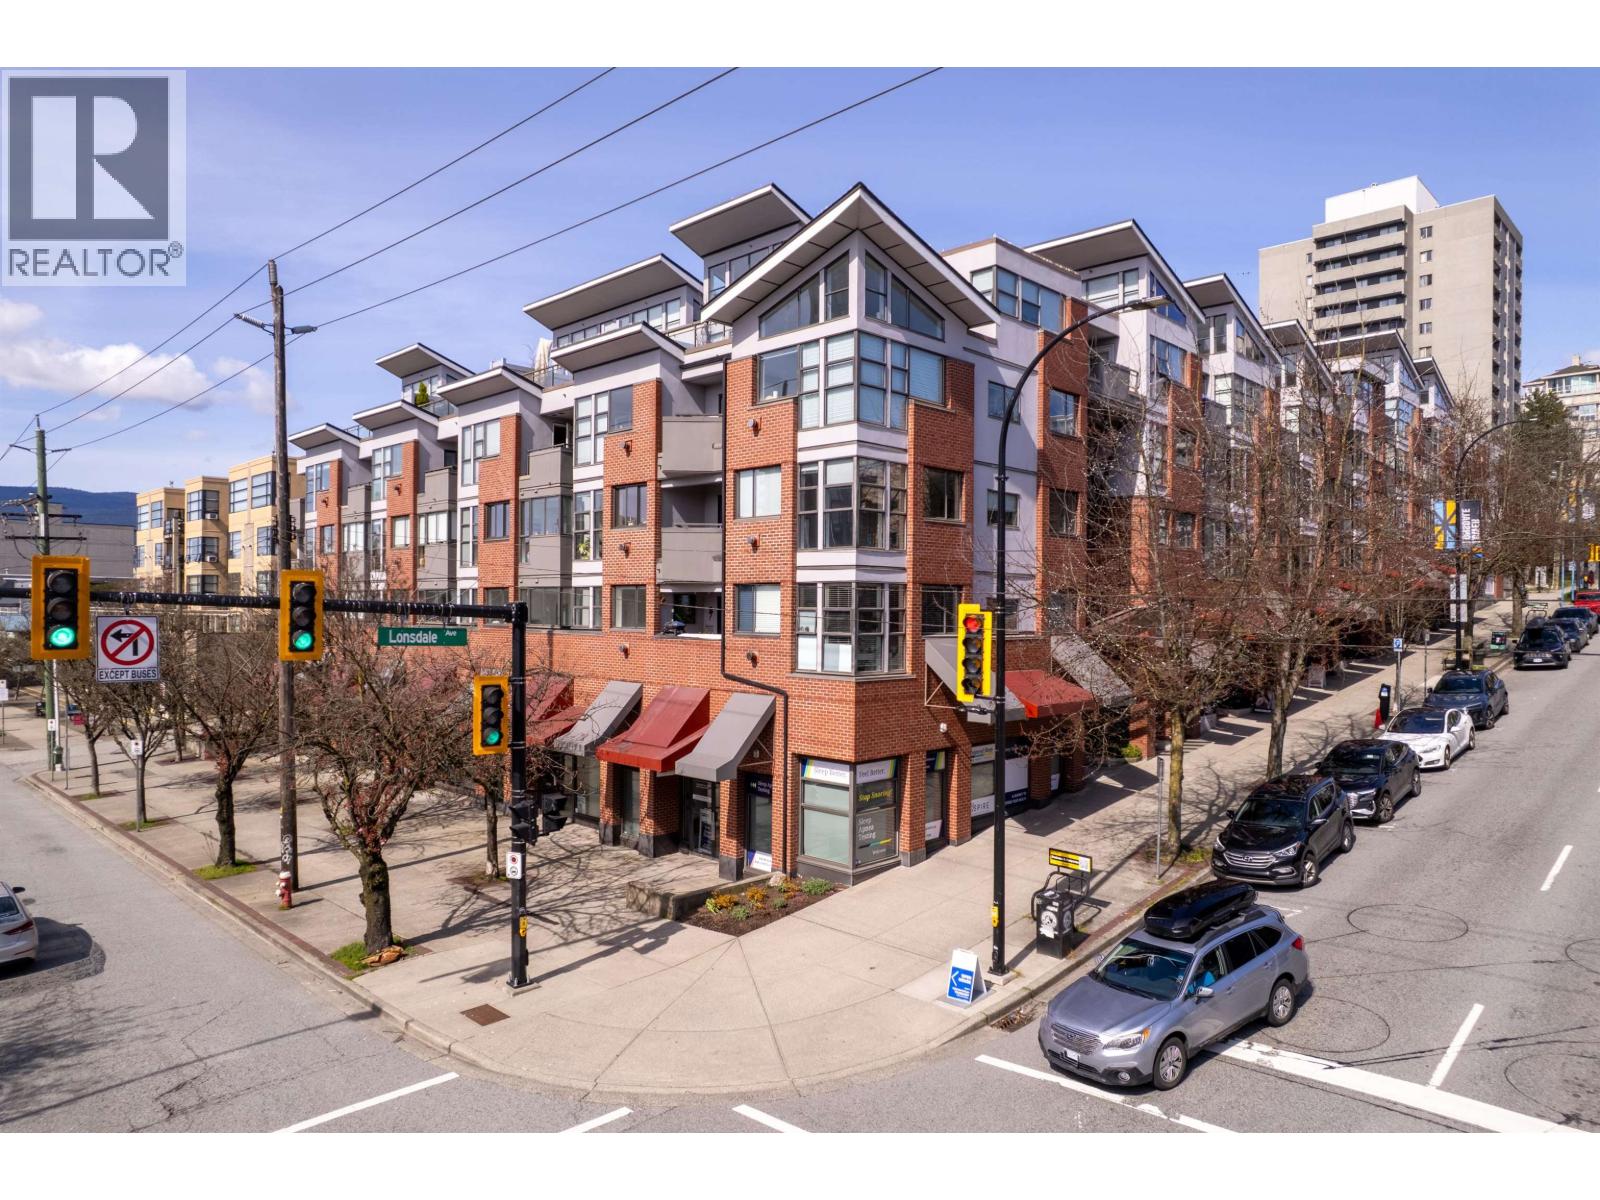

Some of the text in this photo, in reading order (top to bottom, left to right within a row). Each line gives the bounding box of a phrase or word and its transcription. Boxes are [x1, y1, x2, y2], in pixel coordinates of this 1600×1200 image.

[389, 630, 437, 643] Lonsdale
[99, 669, 157, 680] EXCEPT BUSES
